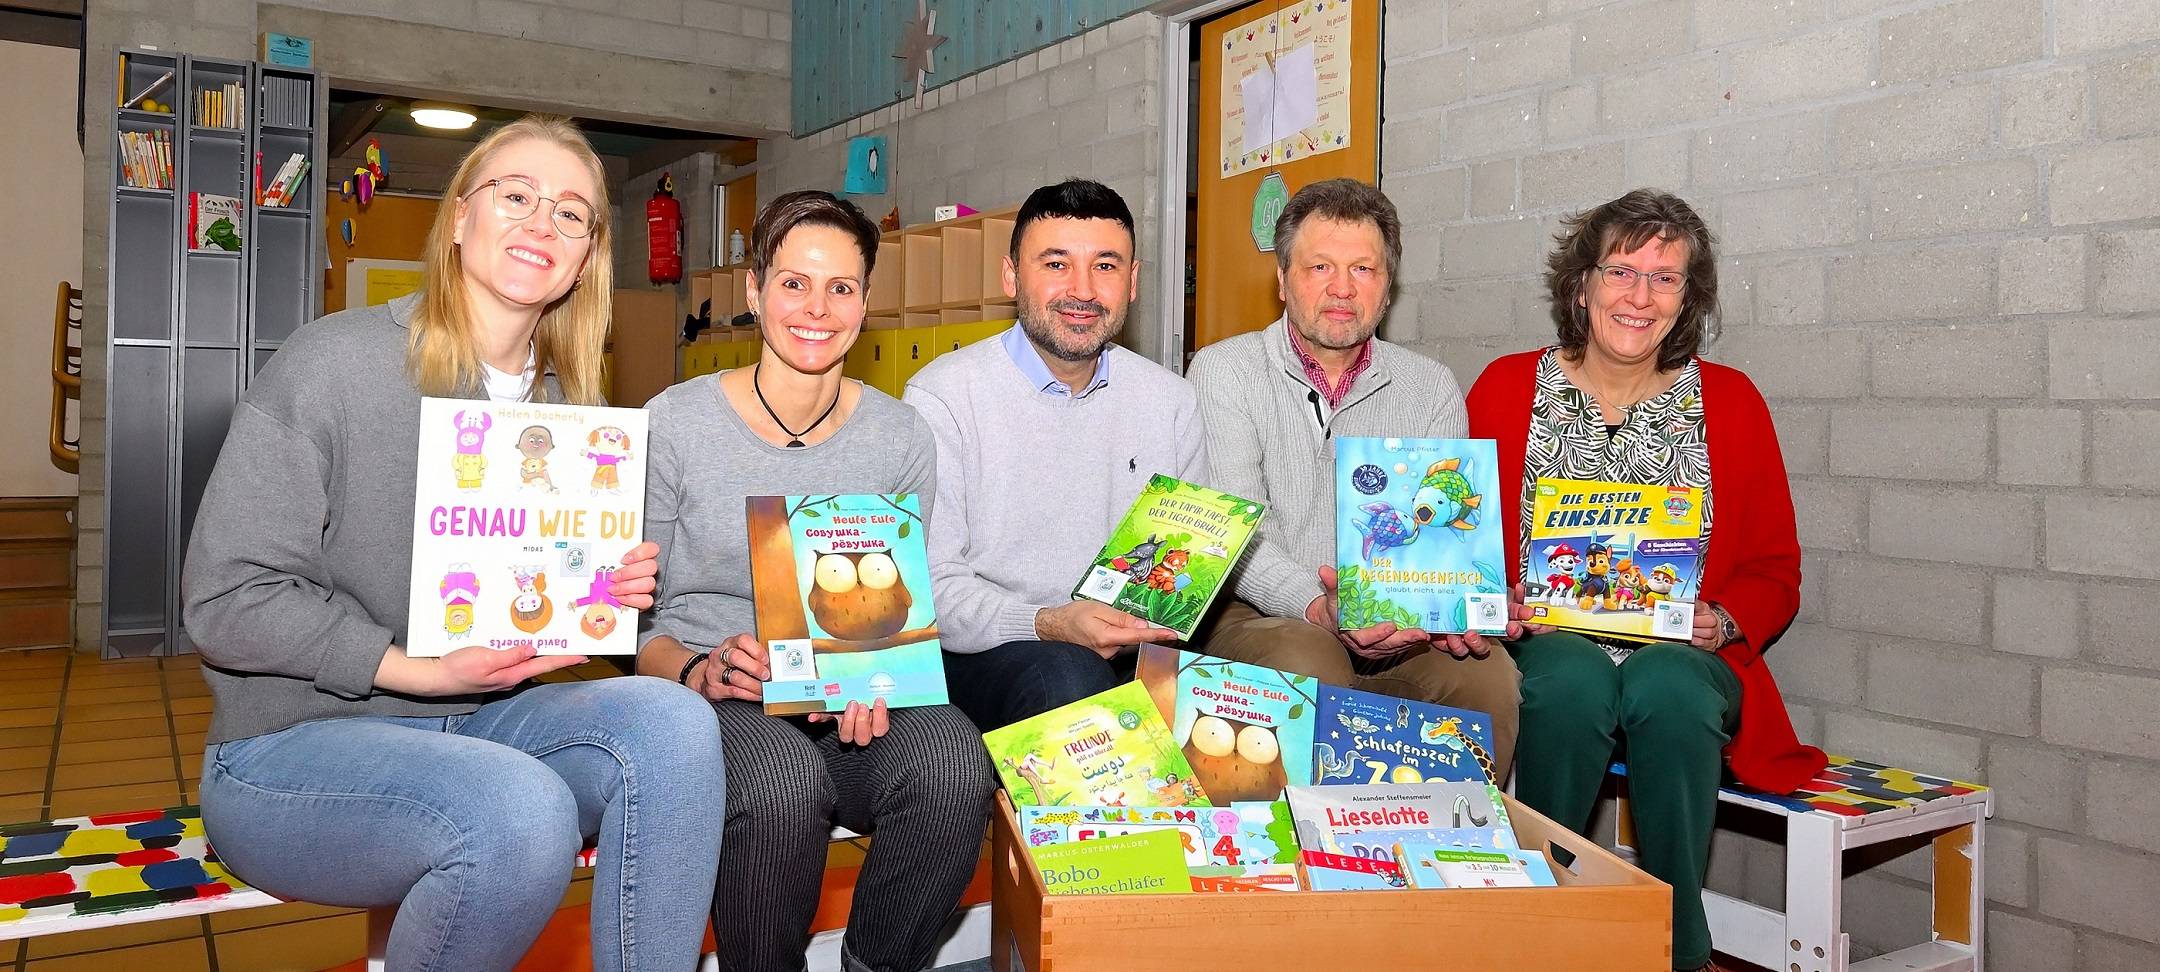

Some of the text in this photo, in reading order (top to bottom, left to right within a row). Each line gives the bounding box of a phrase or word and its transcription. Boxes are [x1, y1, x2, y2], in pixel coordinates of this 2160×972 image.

[1263, 198, 1281, 227] GO
[499, 408, 530, 419] Helen
[1159, 497, 1178, 508] DER
[1178, 501, 1204, 515] TAPIR
[1560, 492, 1641, 504] DIE BESTEN
[430, 506, 635, 539] GENAU WIE DU
[833, 515, 896, 525] Heule Eule
[1148, 507, 1167, 518] DER
[1168, 511, 1193, 525] TIGER
[1545, 505, 1652, 527] EINSÄTZE
[805, 528, 867, 539] Совушка-
[831, 539, 886, 550] рёвушка
[1373, 558, 1392, 568] DER
[1360, 568, 1483, 585] REGENBOGENFISCH
[1385, 586, 1410, 594] glaubt
[537, 639, 567, 648] David
[1193, 687, 1254, 706] Совушка-
[1223, 681, 1258, 695] Heule
[1263, 690, 1289, 702] Eule
[1215, 705, 1272, 723] рёвушка
[1064, 729, 1115, 757] FREUNDE
[1354, 735, 1460, 768] Schlafenszeit
[1082, 756, 1125, 779] دوست
[1402, 754, 1419, 767] im
[1326, 806, 1429, 827] Lieselotte
[1038, 847, 1078, 860] MARKUS
[1082, 840, 1150, 855] OSTERWALDER
[1213, 835, 1241, 865] 4
[1042, 865, 1100, 886] Bobo
[1483, 879, 1497, 887] Mit
